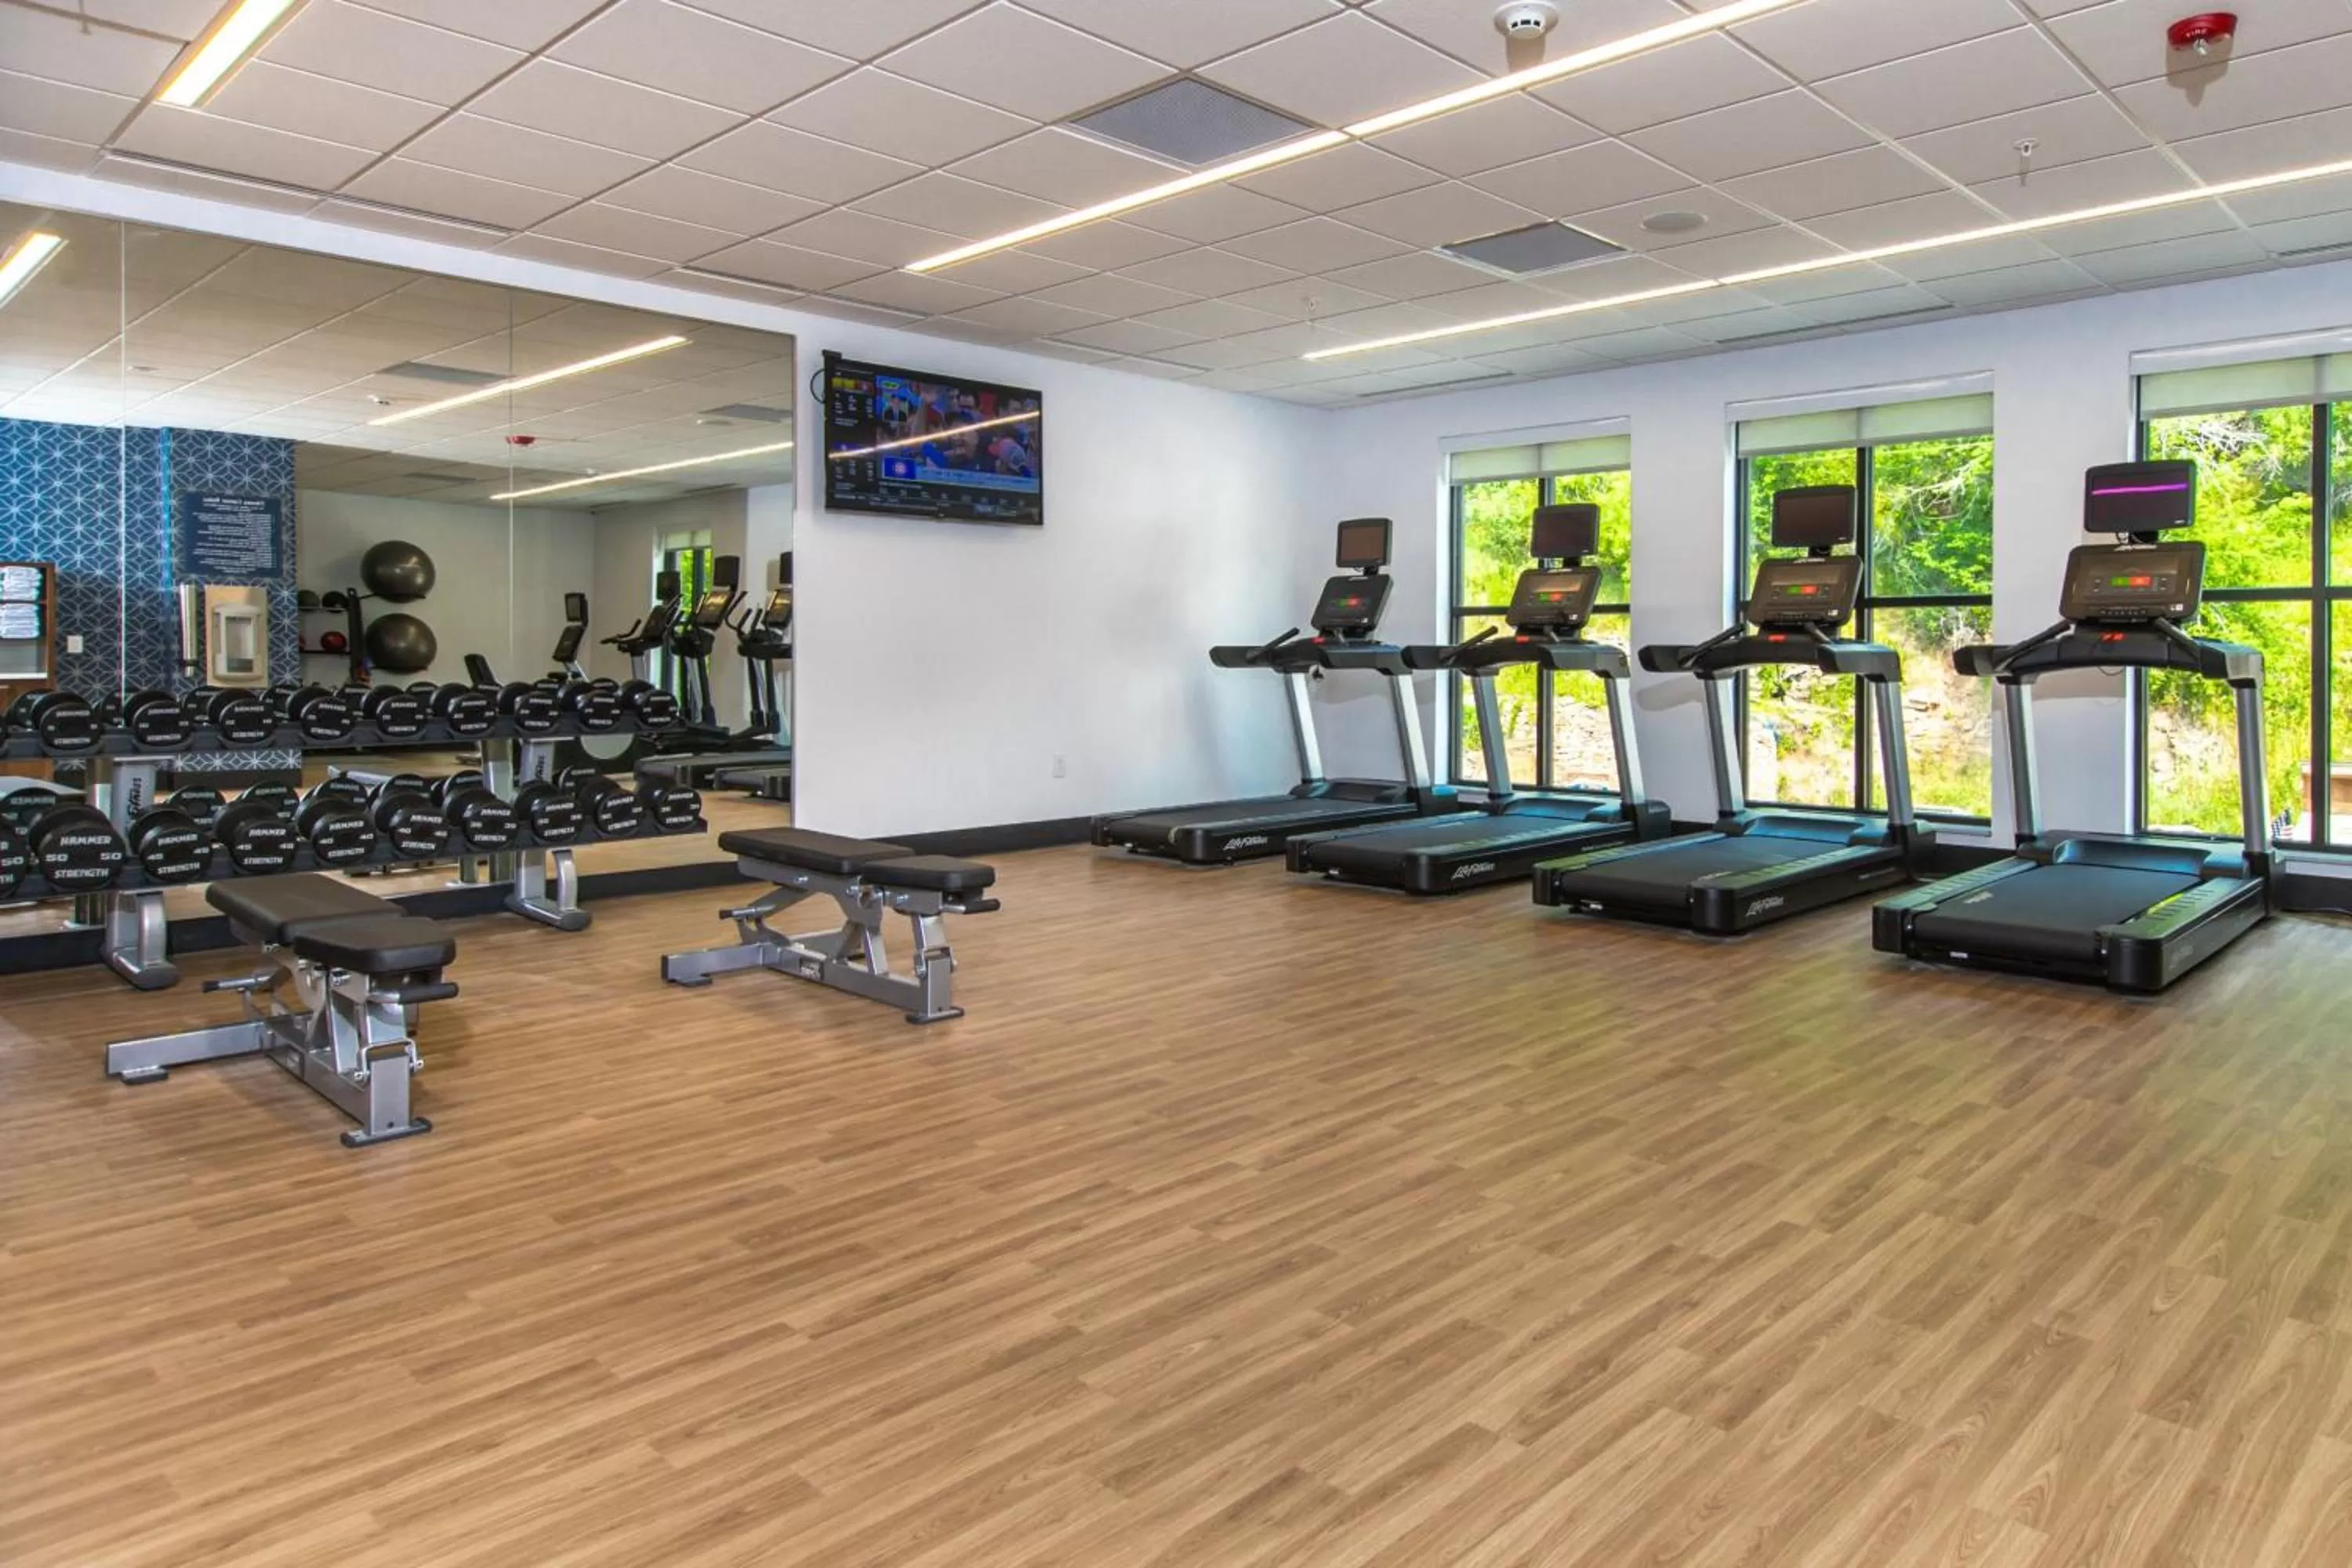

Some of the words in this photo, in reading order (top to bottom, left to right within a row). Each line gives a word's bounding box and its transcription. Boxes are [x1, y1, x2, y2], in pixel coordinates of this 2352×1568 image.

[60, 835, 112, 847] HAMMER
[2, 856, 24, 866] 50
[45, 853, 68, 862] 50
[55, 868, 109, 879] STRENGTH
